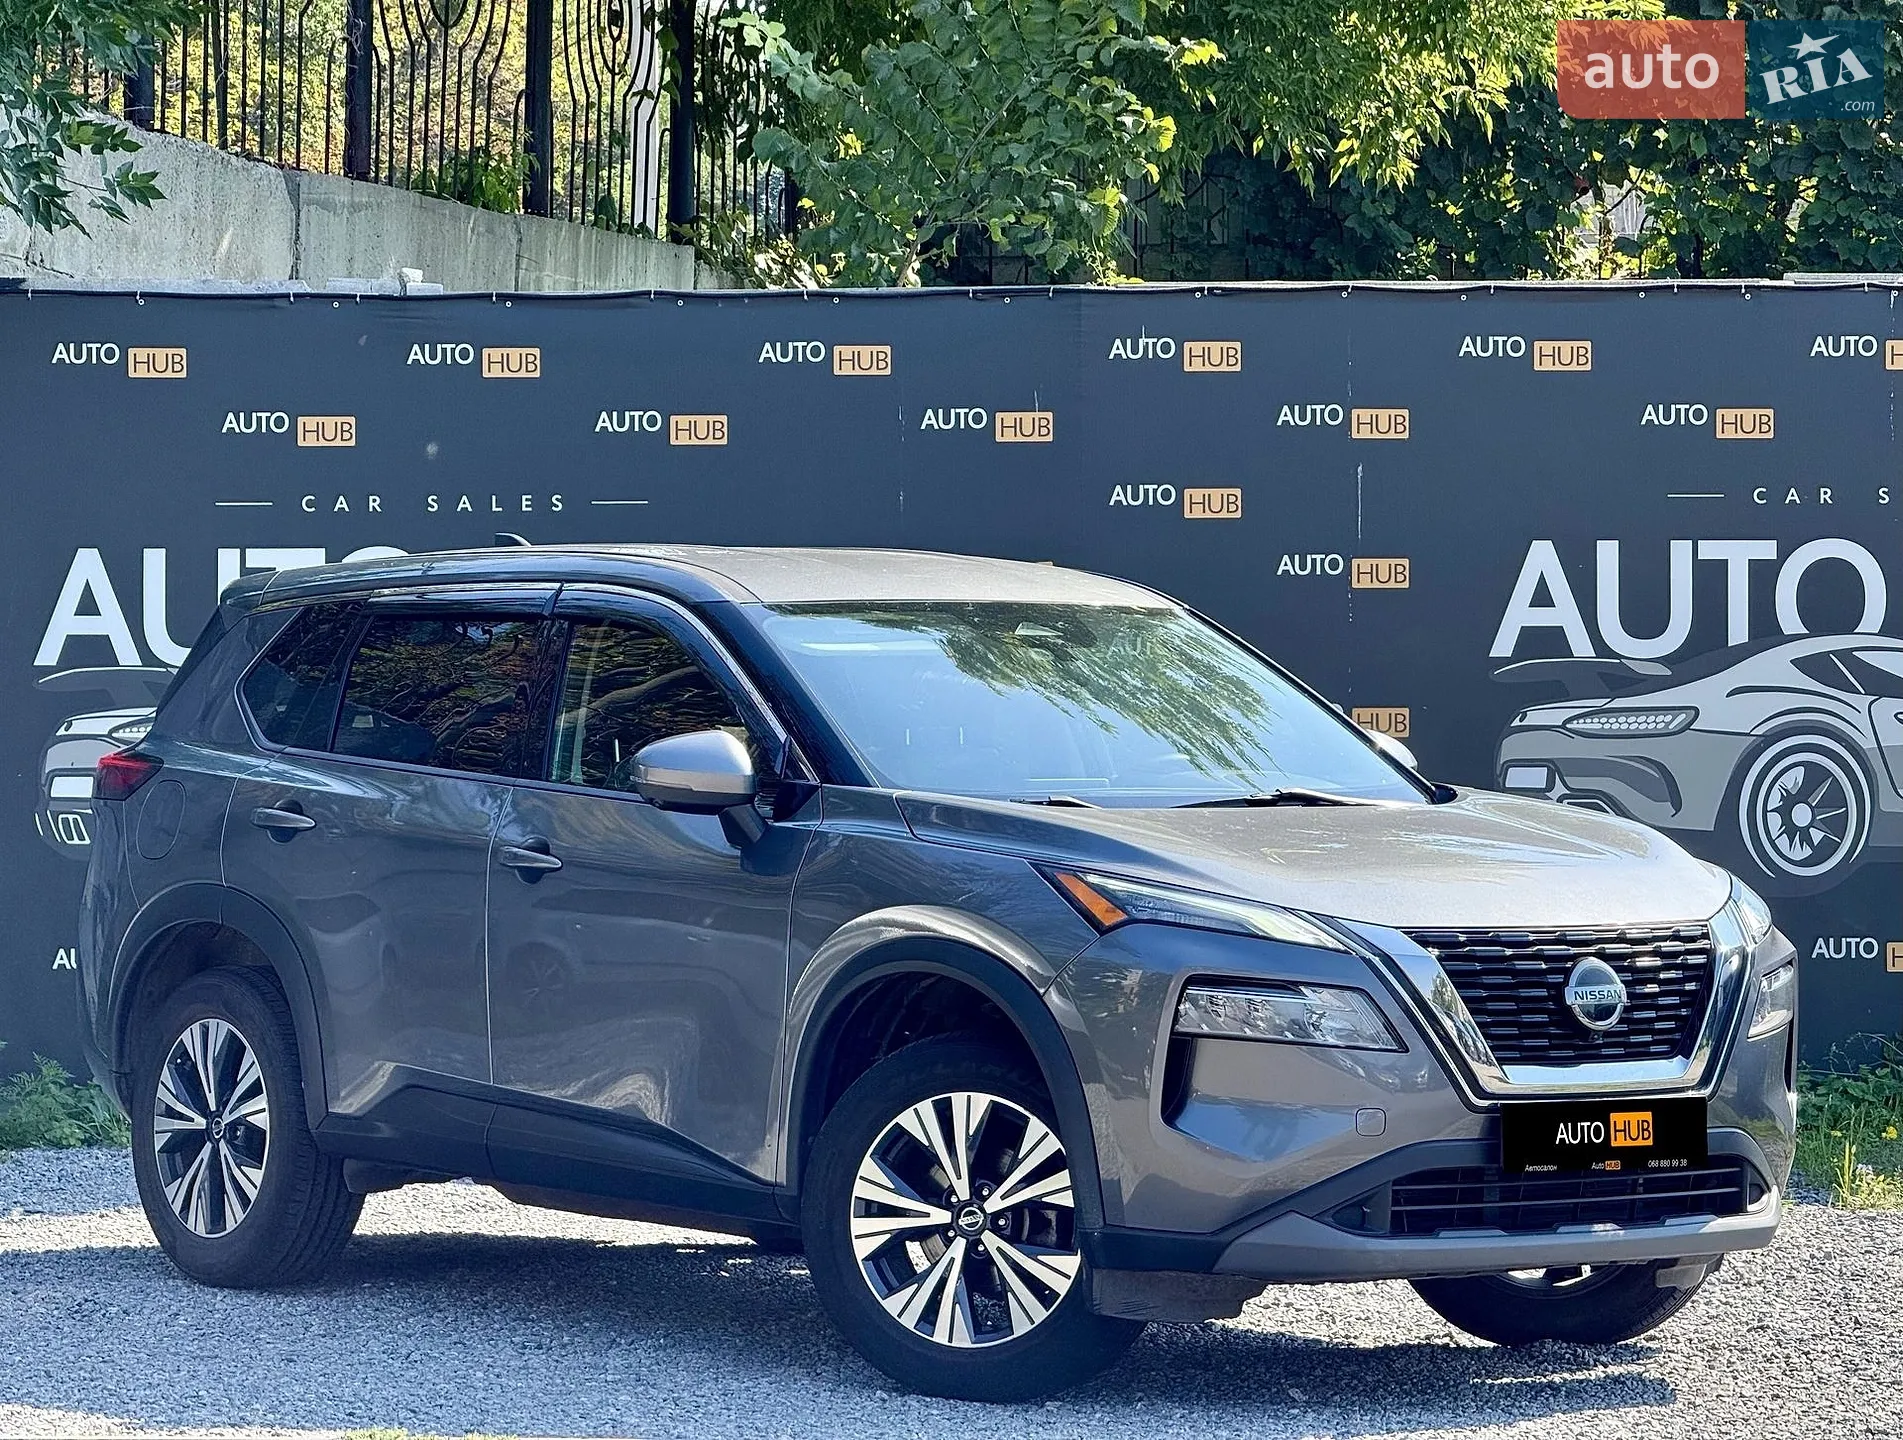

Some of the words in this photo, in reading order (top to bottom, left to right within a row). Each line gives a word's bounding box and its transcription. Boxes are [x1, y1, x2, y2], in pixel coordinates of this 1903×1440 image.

[52, 343, 119, 364] AUTO
[133, 352, 184, 373] HUB
[407, 343, 474, 364] AUTO
[487, 352, 538, 373] HUB
[759, 341, 825, 362] AUTO
[838, 350, 888, 371] HUB
[1109, 338, 1175, 359] AUTO
[1188, 345, 1238, 367] HUB
[1459, 336, 1525, 357] AUTO
[1539, 345, 1589, 366] HUB
[1811, 336, 1877, 356] AUTO
[222, 412, 289, 433] AUTO
[302, 421, 353, 442] HUB
[595, 411, 661, 432] AUTO
[675, 419, 726, 440] HUB
[921, 408, 987, 429] AUTO
[1000, 416, 1050, 437] HUB
[1277, 404, 1343, 425] AUTO
[1356, 413, 1406, 434] HUB
[1641, 404, 1707, 425] AUTO
[1721, 413, 1771, 434] HUB
[302, 495, 381, 512] CAR
[428, 494, 562, 512] SALES
[1110, 485, 1175, 505] AUTO
[1189, 492, 1239, 514] HUB
[1754, 487, 1832, 504] CAR
[1277, 554, 1343, 575] AUTO
[1356, 563, 1406, 584] HUB
[33, 545, 410, 665] AU
[1489, 538, 1887, 658] AUTO
[1357, 712, 1407, 733] HUB
[1811, 937, 1879, 959] AUTO
[1574, 989, 1621, 1000] NISSAN
[1556, 1122, 1604, 1144] AUTO
[1613, 1119, 1651, 1142] HUB
[1591, 1161, 1604, 1170] Auto
[1606, 1161, 1620, 1169] HUB
[1671, 1159, 1679, 1167] 99
[1680, 1158, 1688, 1167] 38
